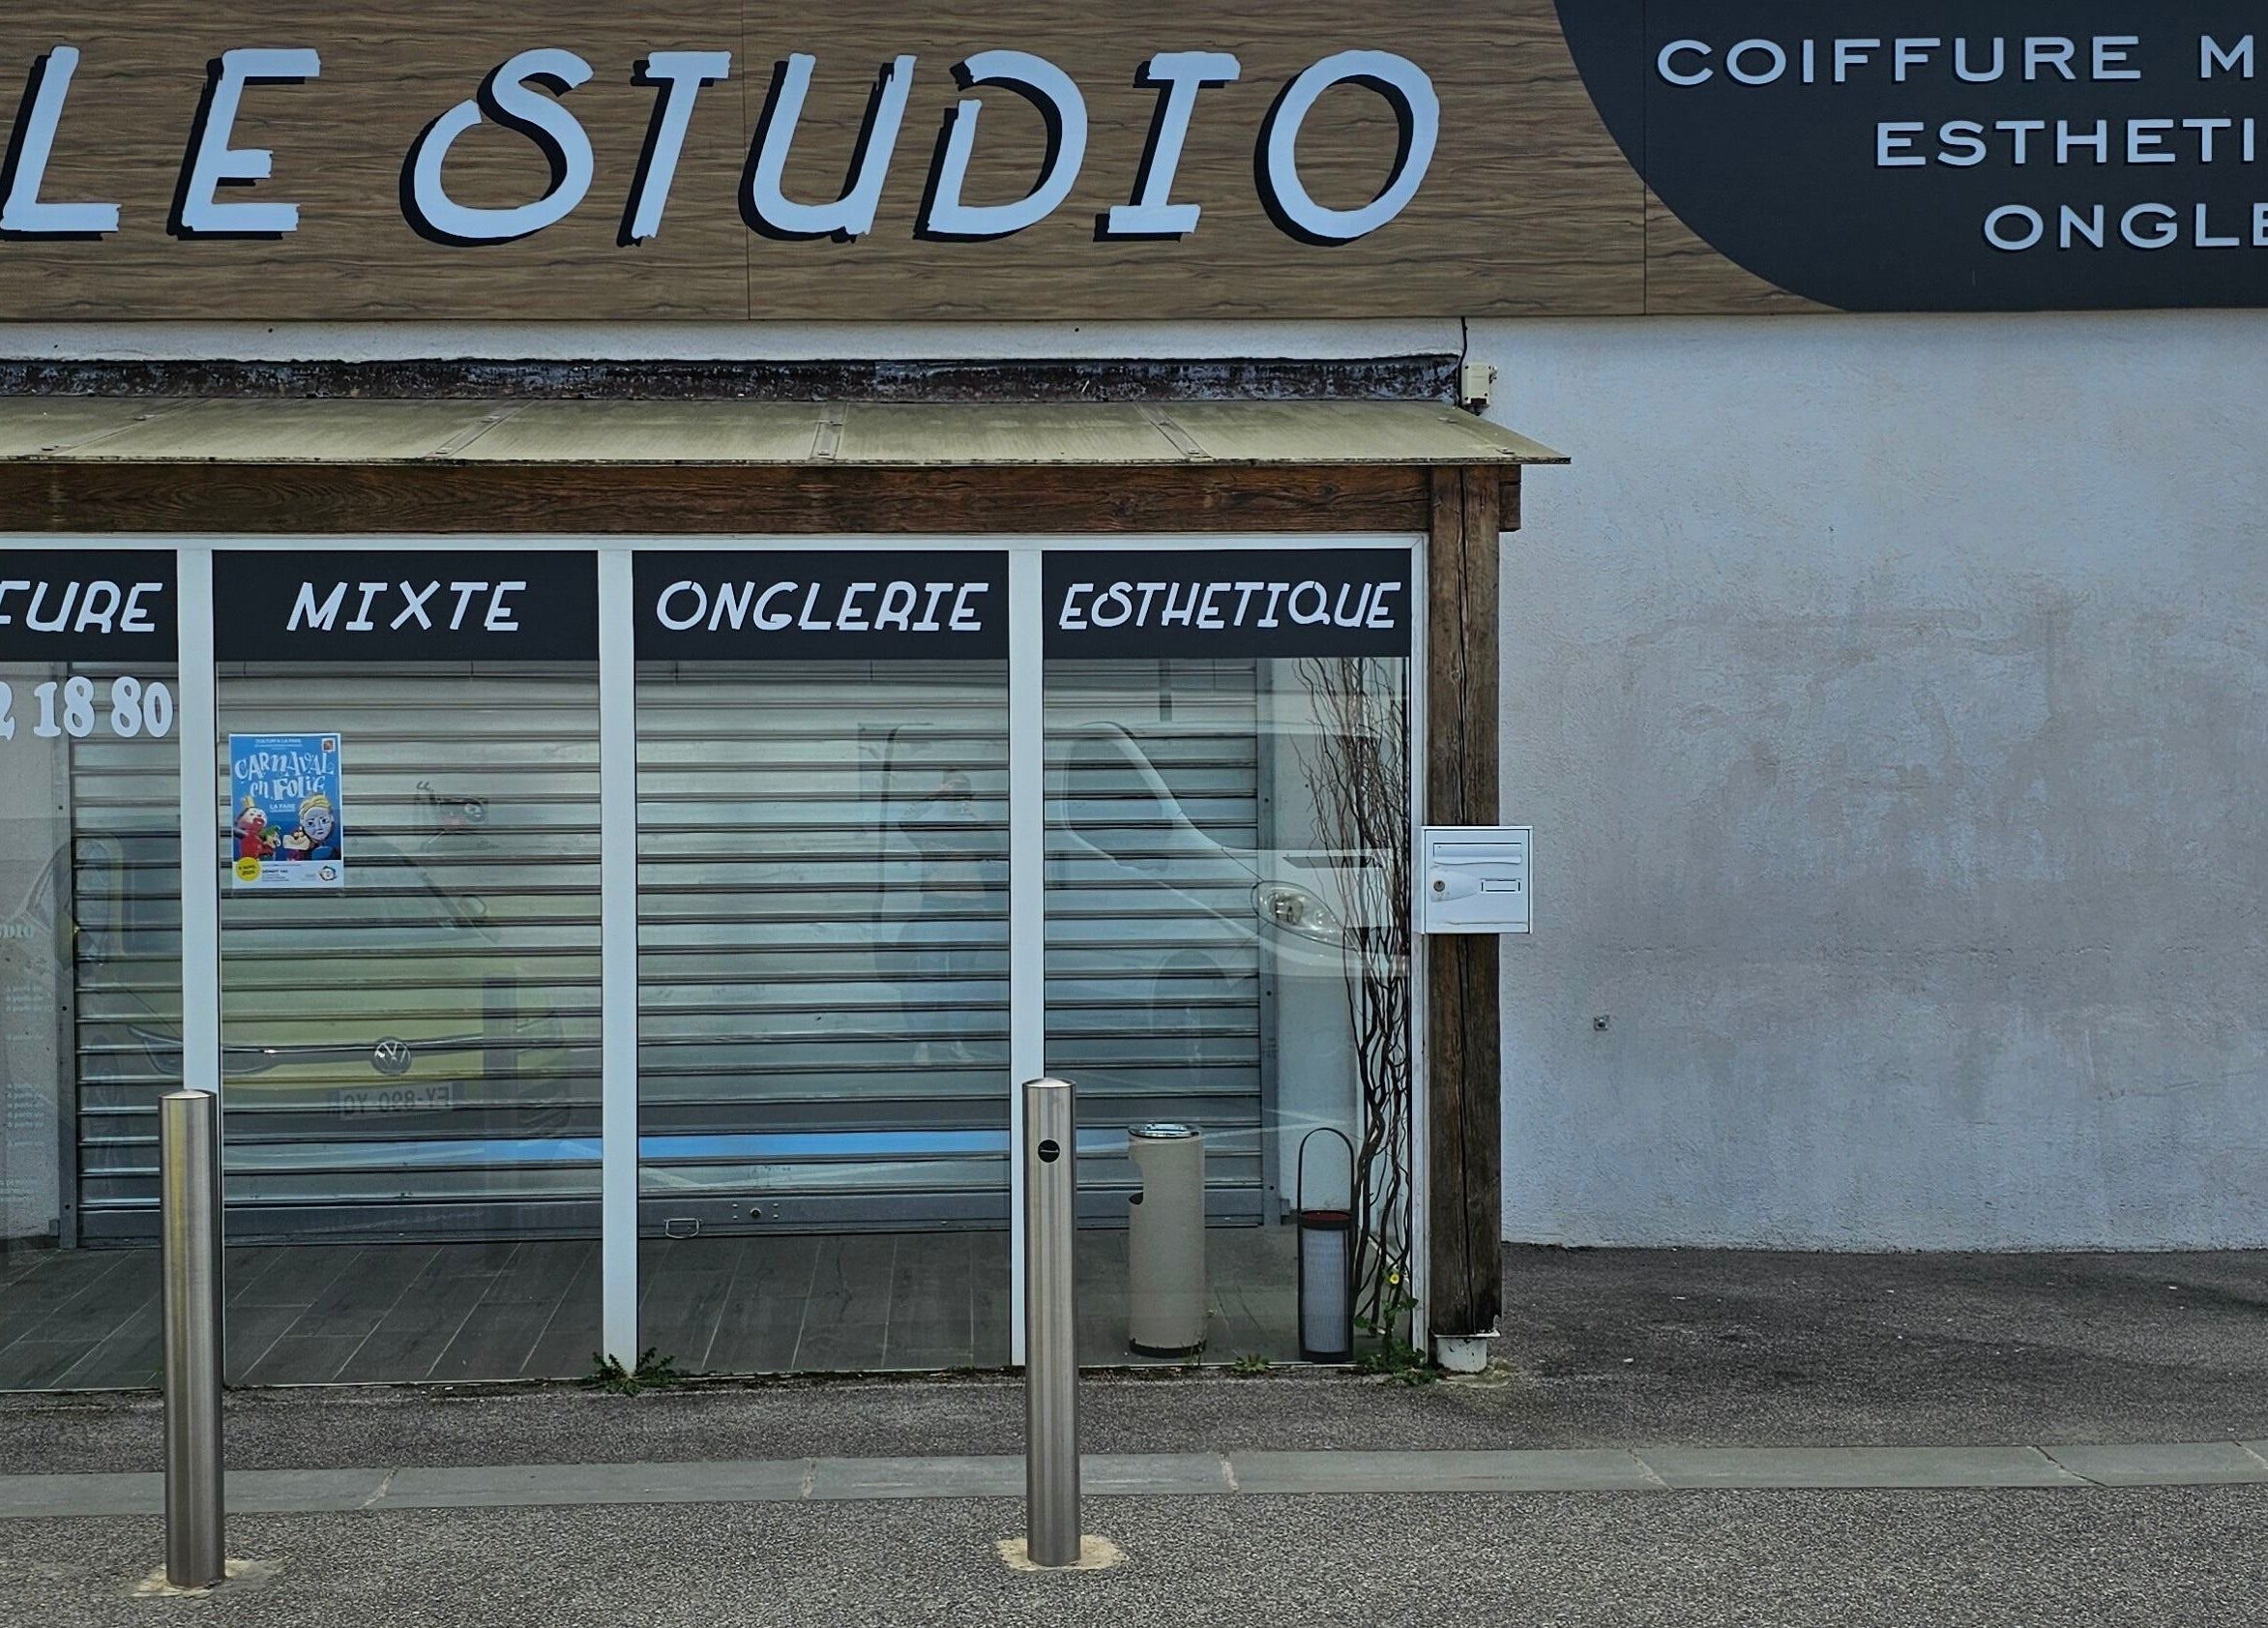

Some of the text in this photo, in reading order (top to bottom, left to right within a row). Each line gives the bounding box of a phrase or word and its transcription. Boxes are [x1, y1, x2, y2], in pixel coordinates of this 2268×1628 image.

[1658, 35, 2253, 85] COIFFURE M
[0, 45, 1439, 239] LE STUDIO
[1878, 118, 2254, 166] ESTHETI
[286, 580, 527, 632] MIXTE
[656, 580, 989, 632] ONGLERIE
[1058, 580, 1401, 630] ESTHETIQUE
[34, 676, 95, 738] 18
[111, 676, 173, 738] 80
